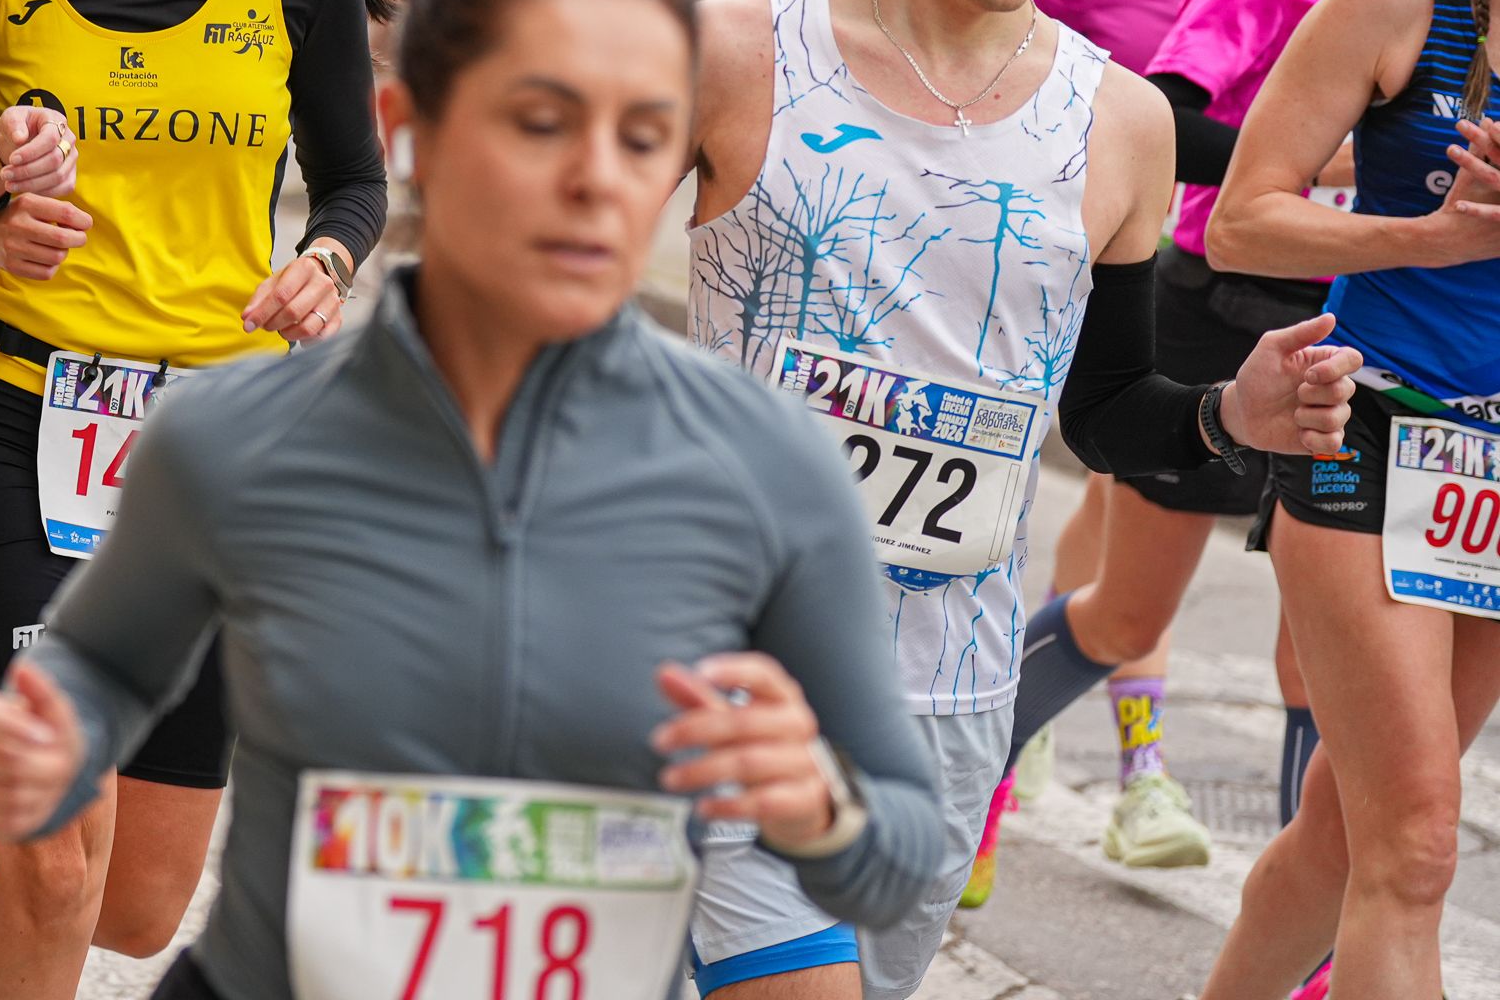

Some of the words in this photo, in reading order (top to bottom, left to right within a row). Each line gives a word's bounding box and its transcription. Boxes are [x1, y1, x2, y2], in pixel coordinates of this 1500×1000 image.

[110, 72, 158, 80] Diputación
[30, 96, 267, 147] IRZONE
[53, 377, 66, 408] MEDIA
[63, 362, 80, 408] MARATÓN
[77, 365, 149, 418] 21K
[806, 359, 897, 428] 21K
[932, 422, 964, 442] 2026
[974, 415, 1024, 433] populares
[977, 408, 1018, 423] carreras
[1422, 427, 1485, 478] 21K
[1312, 471, 1360, 484] Maratón
[1312, 484, 1356, 495] Lucena
[1425, 482, 1500, 557] 90
[334, 795, 458, 878] 10K
[388, 894, 593, 1000] 718
